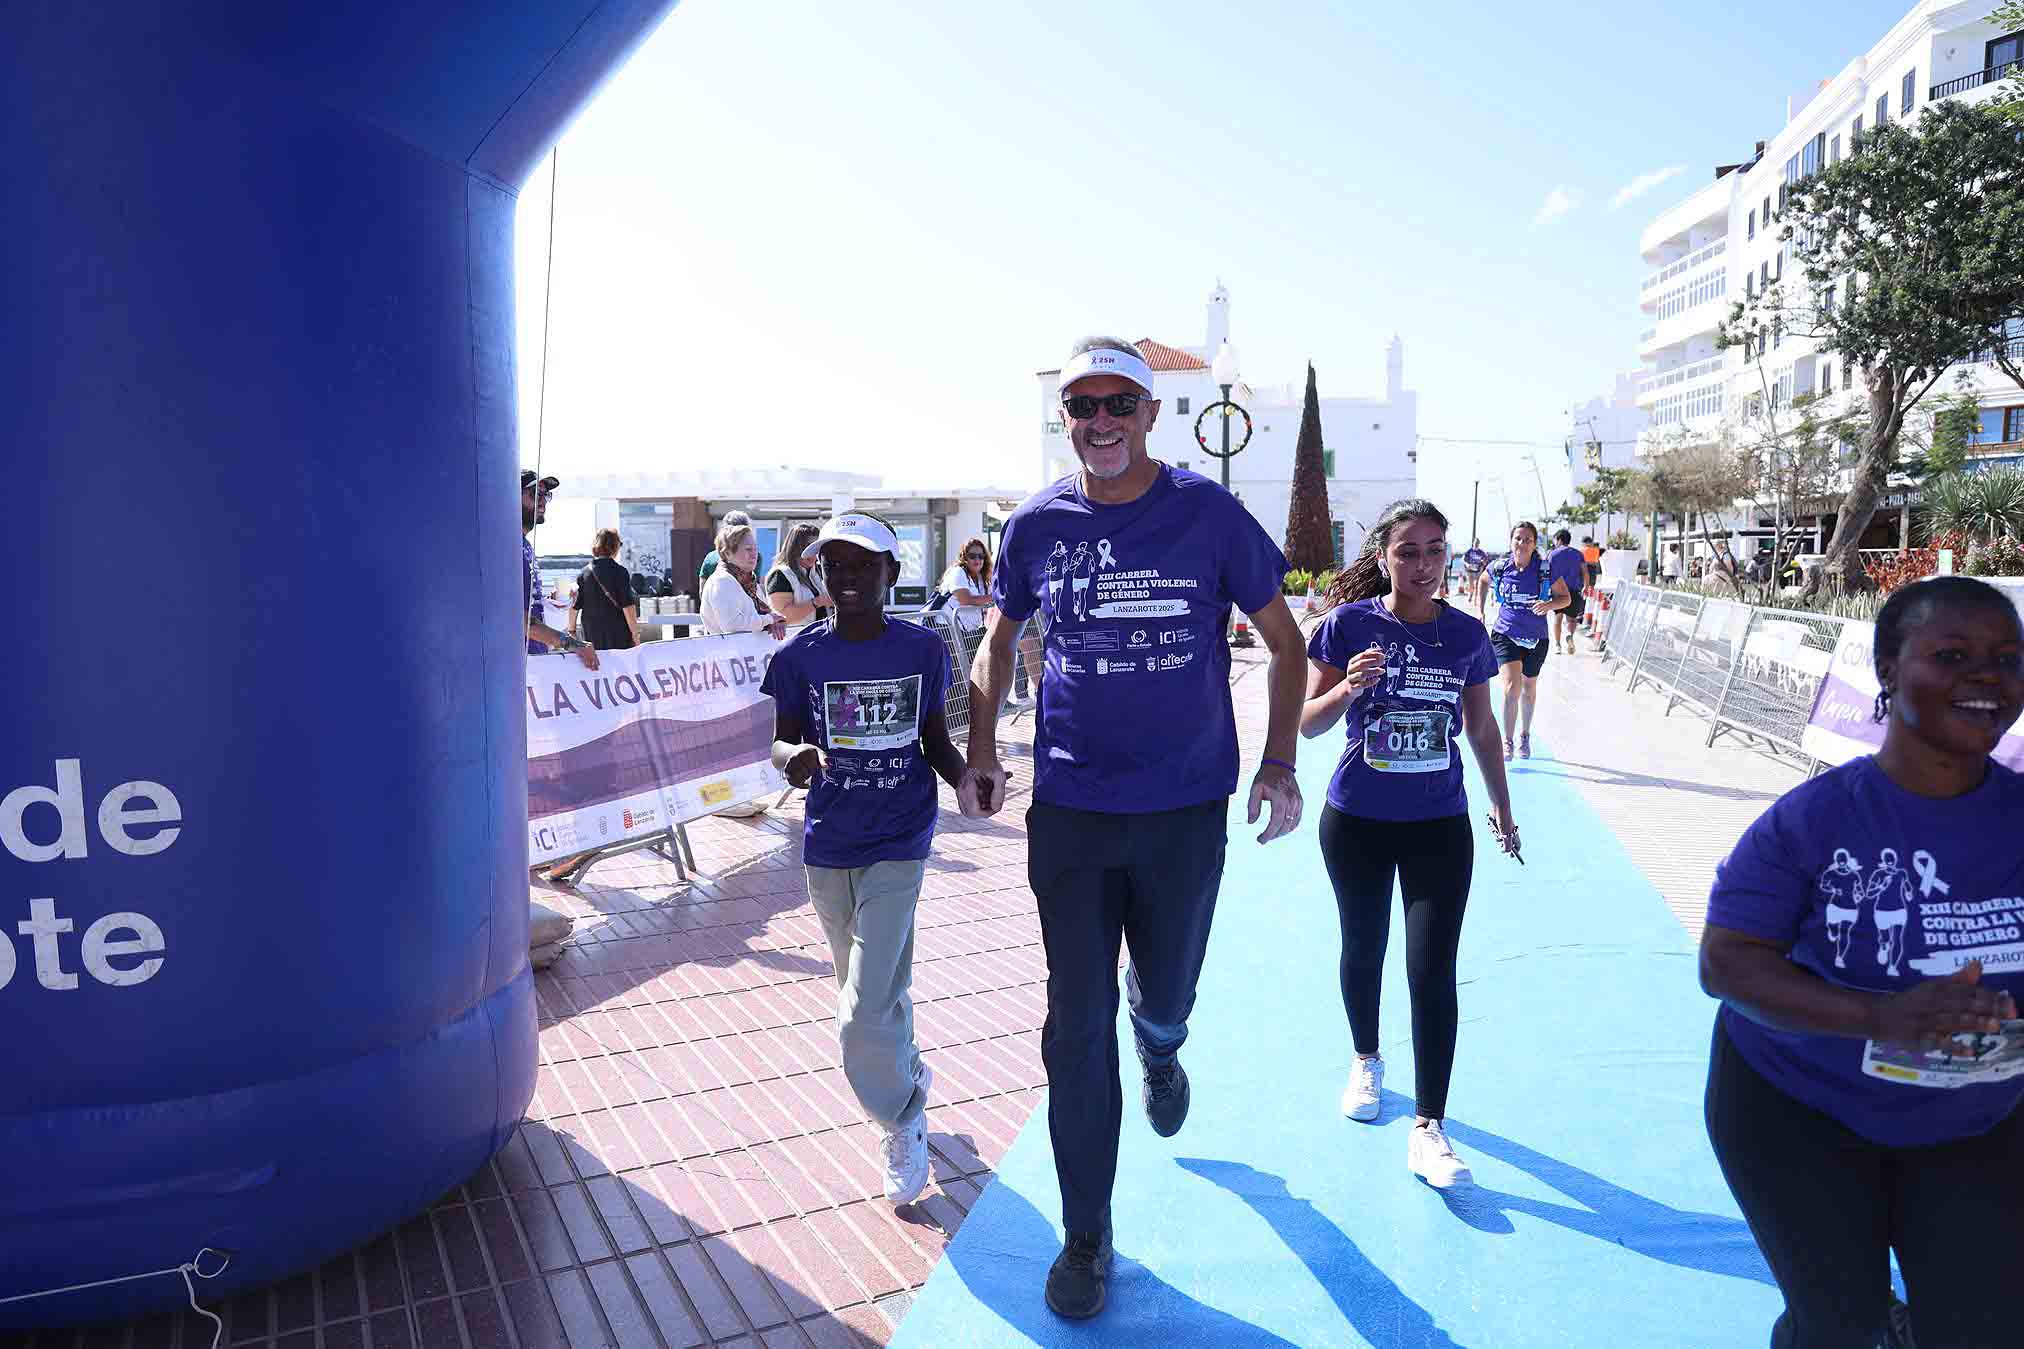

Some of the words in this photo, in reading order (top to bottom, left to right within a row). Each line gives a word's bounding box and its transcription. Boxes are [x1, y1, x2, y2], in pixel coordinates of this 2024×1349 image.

[1097, 573, 1114, 581] XIII
[1114, 569, 1160, 580] CARRERA
[1096, 580, 1136, 590] CONTRA
[1136, 580, 1150, 589] LA
[1096, 591, 1111, 600] DE
[1111, 589, 1150, 600] GÉNERO
[1113, 604, 1157, 613] LANZAROTE
[1158, 604, 1175, 612] 2025
[1406, 673, 1435, 682] CONTRA
[1435, 675, 1444, 683] LA
[1419, 667, 1452, 676] CARRERA
[527, 681, 579, 719] LA
[580, 659, 729, 710] VIOLENCIA
[729, 656, 761, 686] DE
[854, 703, 898, 726] 112
[1388, 731, 1429, 752] 016
[0, 758, 182, 863] de
[1919, 902, 1952, 915] XIII
[1922, 916, 1990, 930] CONTRA
[1989, 911, 2017, 926] LA
[0, 897, 166, 991] te
[1924, 932, 1949, 945] DE
[1949, 926, 2020, 946] GÉNERO
